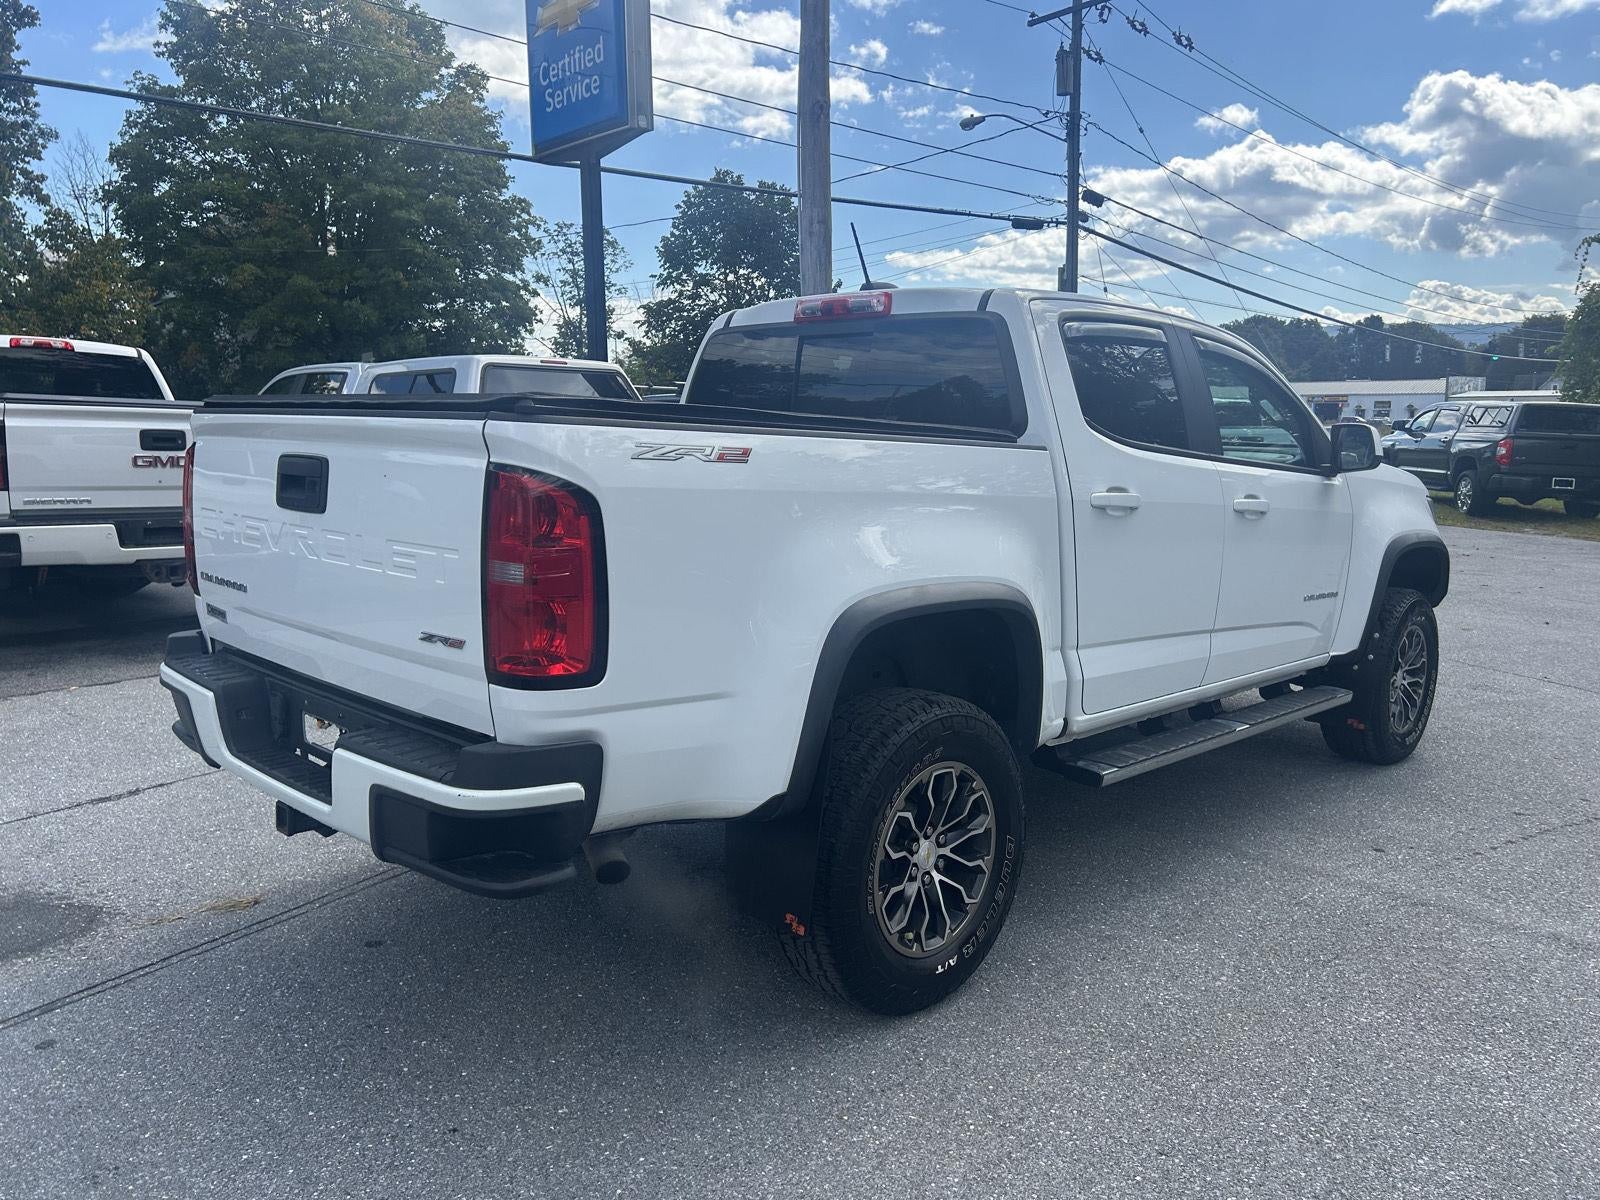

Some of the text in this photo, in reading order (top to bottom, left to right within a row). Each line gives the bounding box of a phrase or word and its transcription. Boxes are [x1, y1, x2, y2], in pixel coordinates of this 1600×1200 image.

[539, 36, 604, 86] Certified
[544, 75, 600, 112] Service
[630, 442, 752, 464] ZR2
[200, 507, 459, 584] CHEVROLET
[418, 631, 466, 650] ZR2
[935, 835, 1016, 975] DUELER A/T
